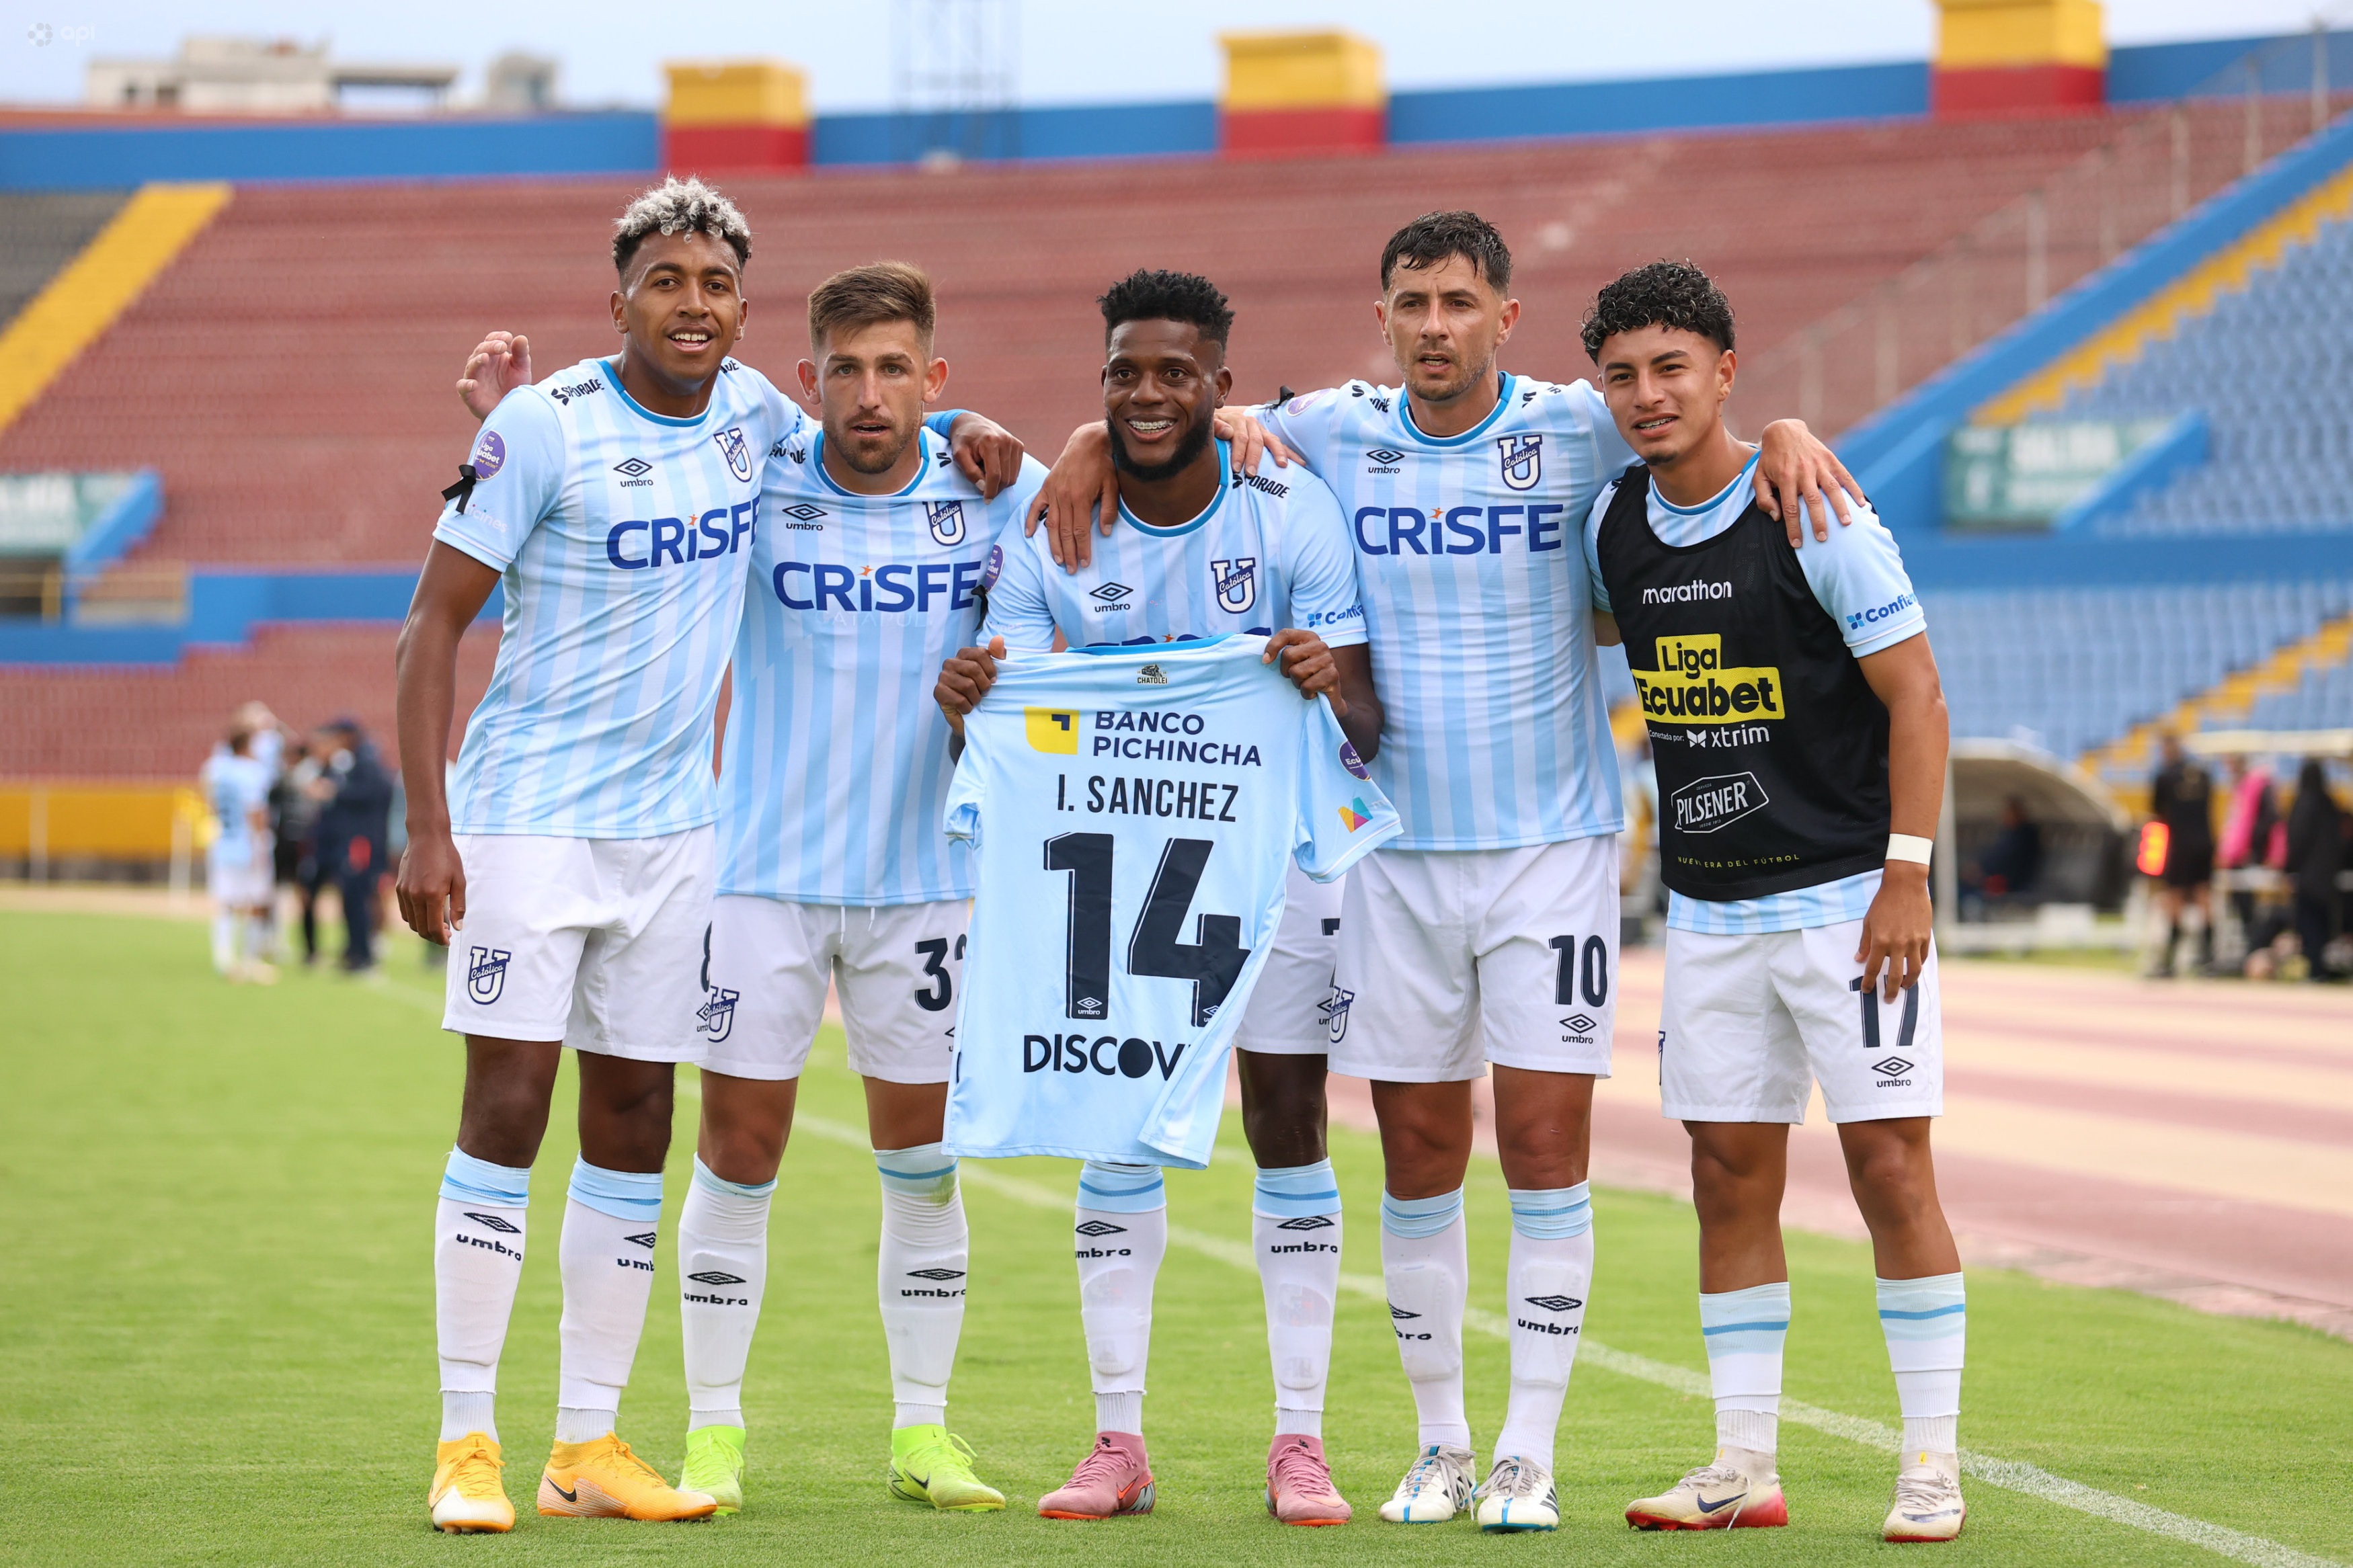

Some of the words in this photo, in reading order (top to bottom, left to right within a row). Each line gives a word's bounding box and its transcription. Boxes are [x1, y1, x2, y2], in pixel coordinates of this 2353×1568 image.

[476, 447, 500, 464] uabet
[481, 442, 493, 452] Liga
[1505, 448, 1538, 468] Católica
[1367, 466, 1400, 474] umbro
[620, 478, 653, 488] umbro
[1245, 474, 1290, 499] ORADE
[931, 505, 960, 526] Católica
[786, 522, 824, 532] umbro
[1219, 571, 1252, 593] Católica
[1642, 579, 1732, 605] marathon
[1094, 602, 1131, 612] umbro
[1661, 642, 1717, 679] Liga
[1637, 677, 1778, 717] Ecuabet
[1094, 710, 1205, 735] BANCO
[1711, 723, 1770, 748] xtrim
[1092, 736, 1262, 767] PICHINCHA
[1057, 774, 1075, 812] I.
[1086, 775, 1239, 823] SANCHEZ
[1676, 781, 1749, 826] PILSENER
[1727, 860, 1749, 868] DEL
[1753, 854, 1800, 865] FÚTBOL
[1043, 831, 1252, 1028] 14
[471, 964, 504, 979] Católica
[1549, 935, 1607, 1007] 10
[709, 1002, 733, 1016] atólica
[1849, 974, 1919, 1048] 17
[696, 1023, 710, 1032] umb
[1562, 1034, 1594, 1044] umbro
[1023, 1033, 1192, 1081] DISCOV
[1876, 1077, 1911, 1088] umbro
[456, 1233, 522, 1261] umbro
[1074, 1247, 1131, 1259] mbro
[1271, 1241, 1338, 1253] umbro
[617, 1257, 655, 1272] umb
[684, 1292, 748, 1306] umbro
[1392, 1320, 1433, 1341] bro
[1517, 1318, 1579, 1336] umbro
